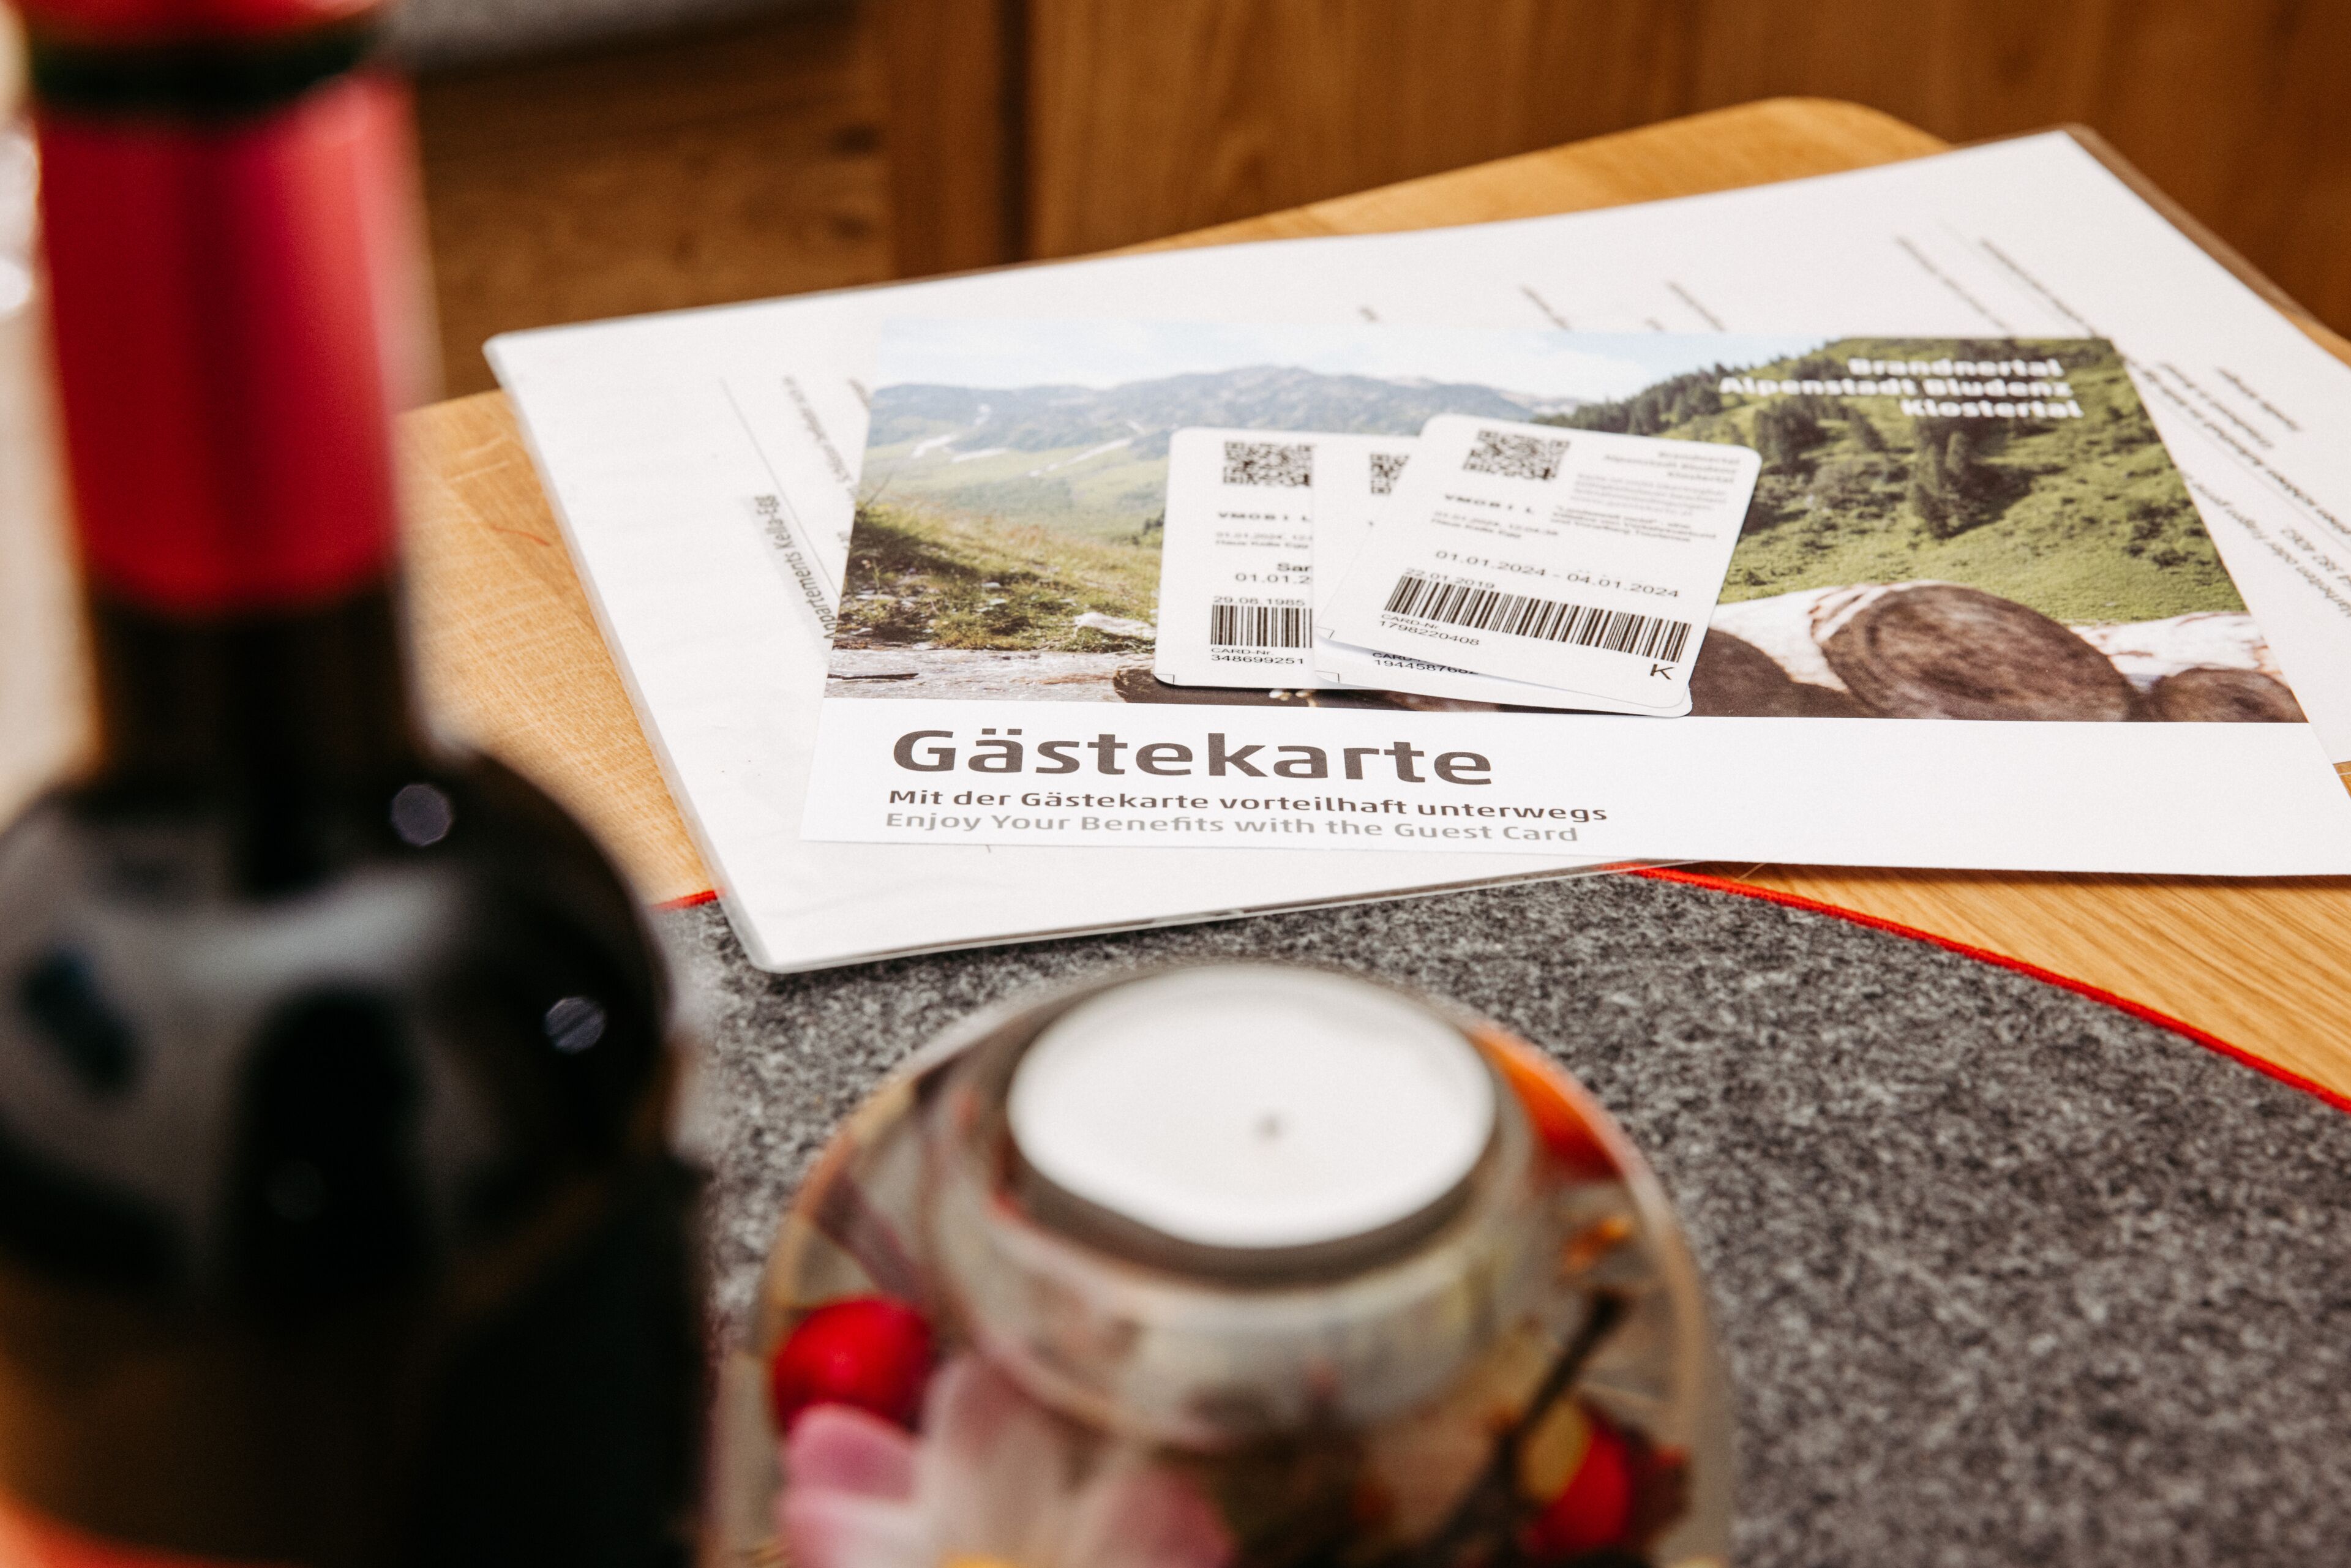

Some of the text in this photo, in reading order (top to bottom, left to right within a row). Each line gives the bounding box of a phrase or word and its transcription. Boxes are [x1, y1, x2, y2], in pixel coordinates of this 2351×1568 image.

[1847, 358, 2064, 377] Brandnertal
[1719, 377, 2074, 397] Alpenstadt Bludenz
[1900, 399, 2084, 418] Klostertal
[1435, 550, 1547, 577] 01.01.2024
[1566, 573, 1680, 598] 04.01.2024
[1380, 621, 1479, 646] 1798220408
[1211, 655, 1304, 665] 348699251
[1649, 663, 1676, 681] K
[892, 729, 1493, 786] Gästekarte
[890, 790, 1607, 823] Mit der Gästekarte vorteilhaft unterwegs
[887, 813, 1577, 842] Enjoy Your Benefits with the Guest Card
